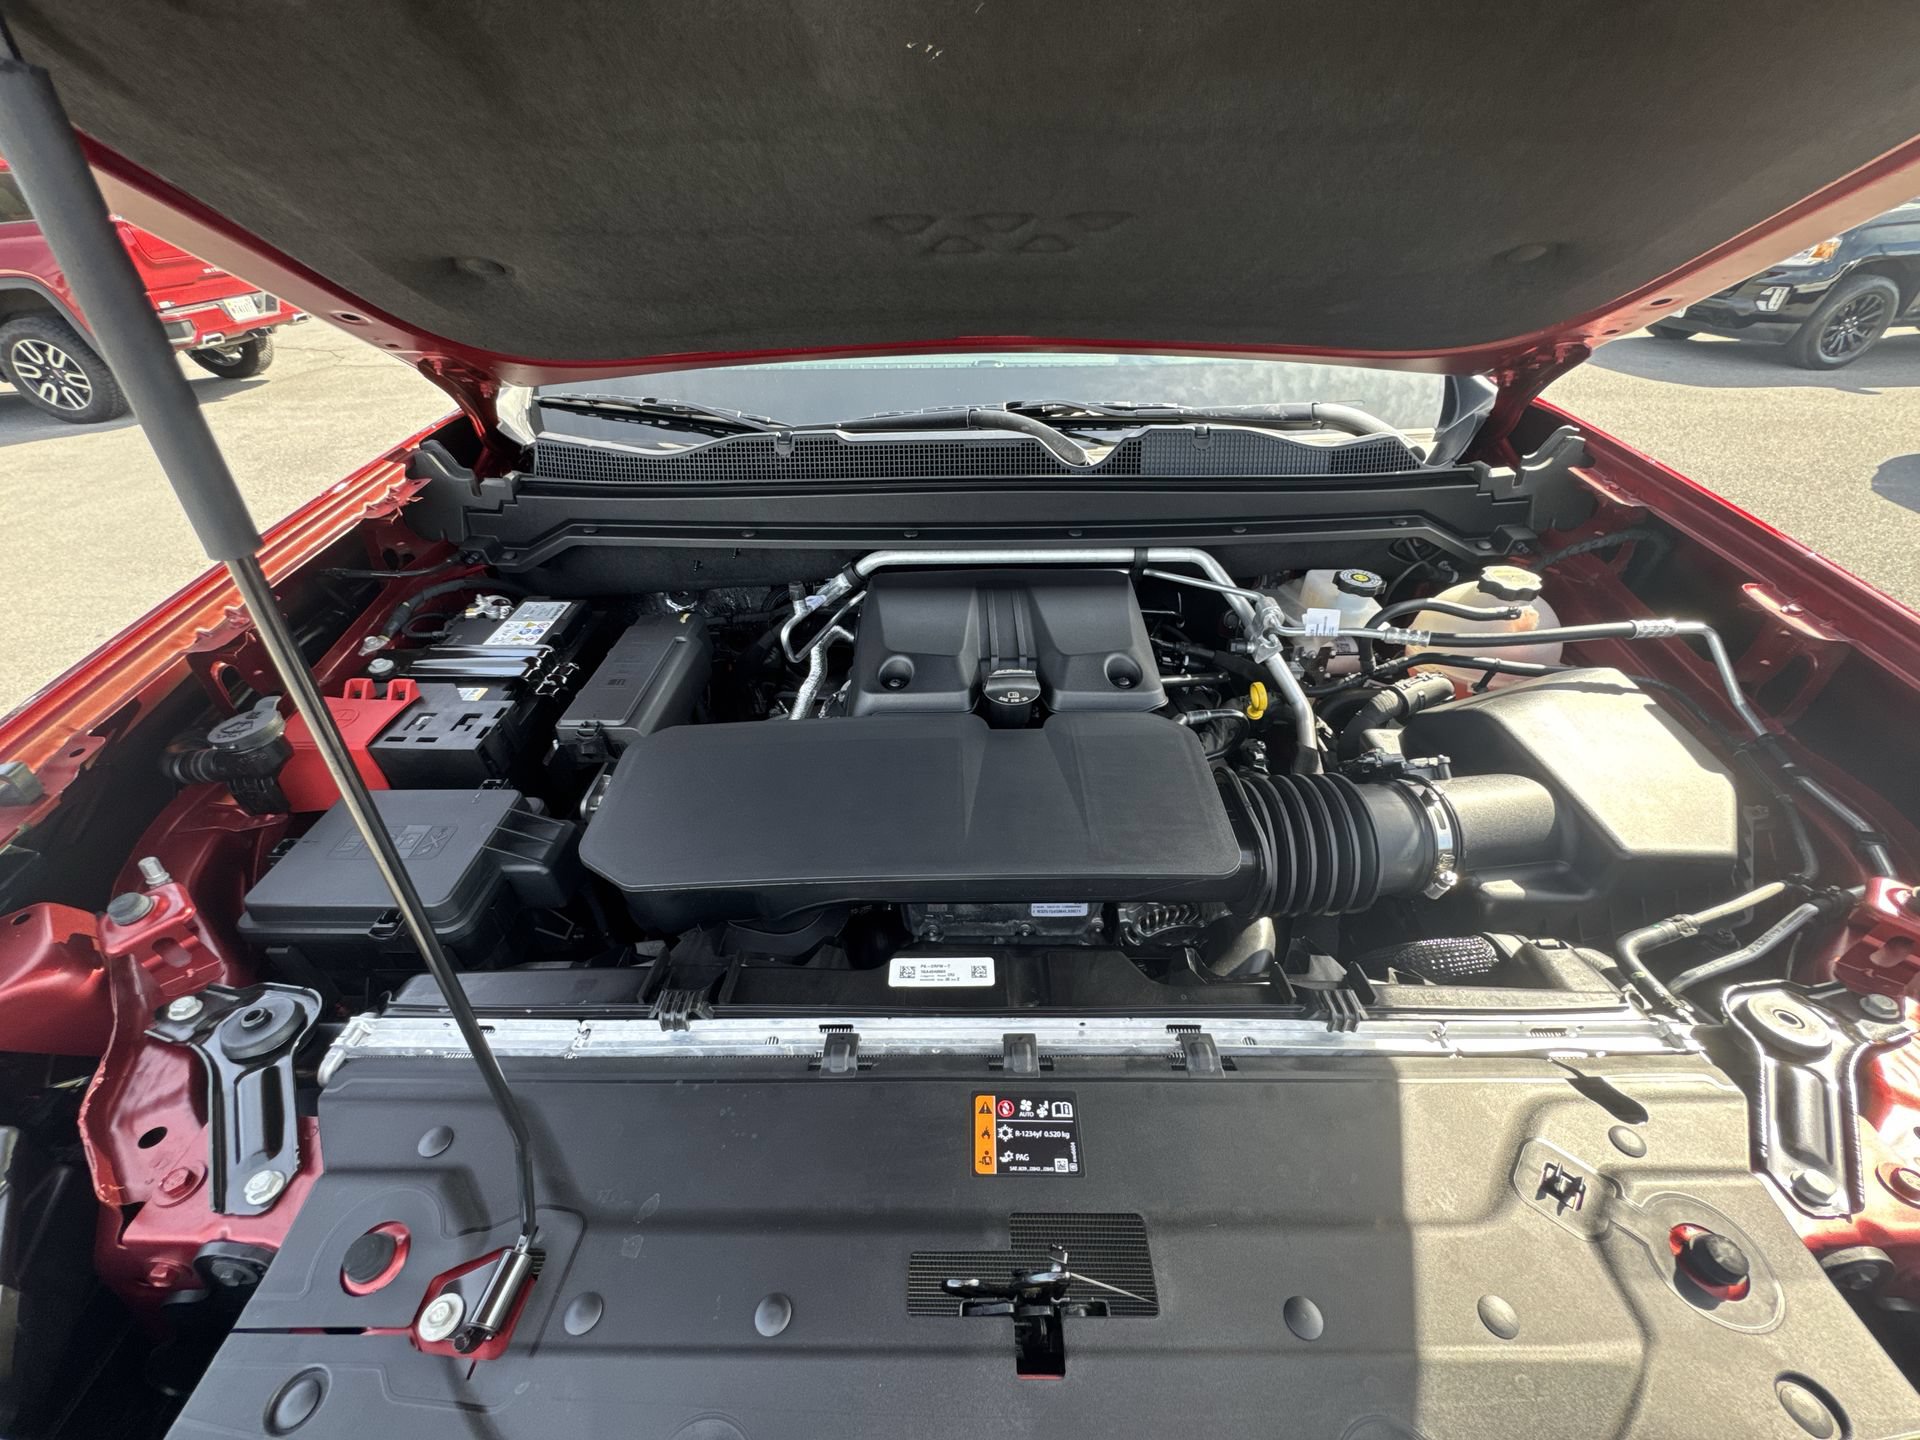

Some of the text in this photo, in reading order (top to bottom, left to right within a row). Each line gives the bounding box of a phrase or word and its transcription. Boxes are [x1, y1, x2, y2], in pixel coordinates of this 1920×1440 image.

[1015, 1130, 1070, 1139] R-1234yf 0.520 kg
[1015, 1153, 1029, 1161] PAG
